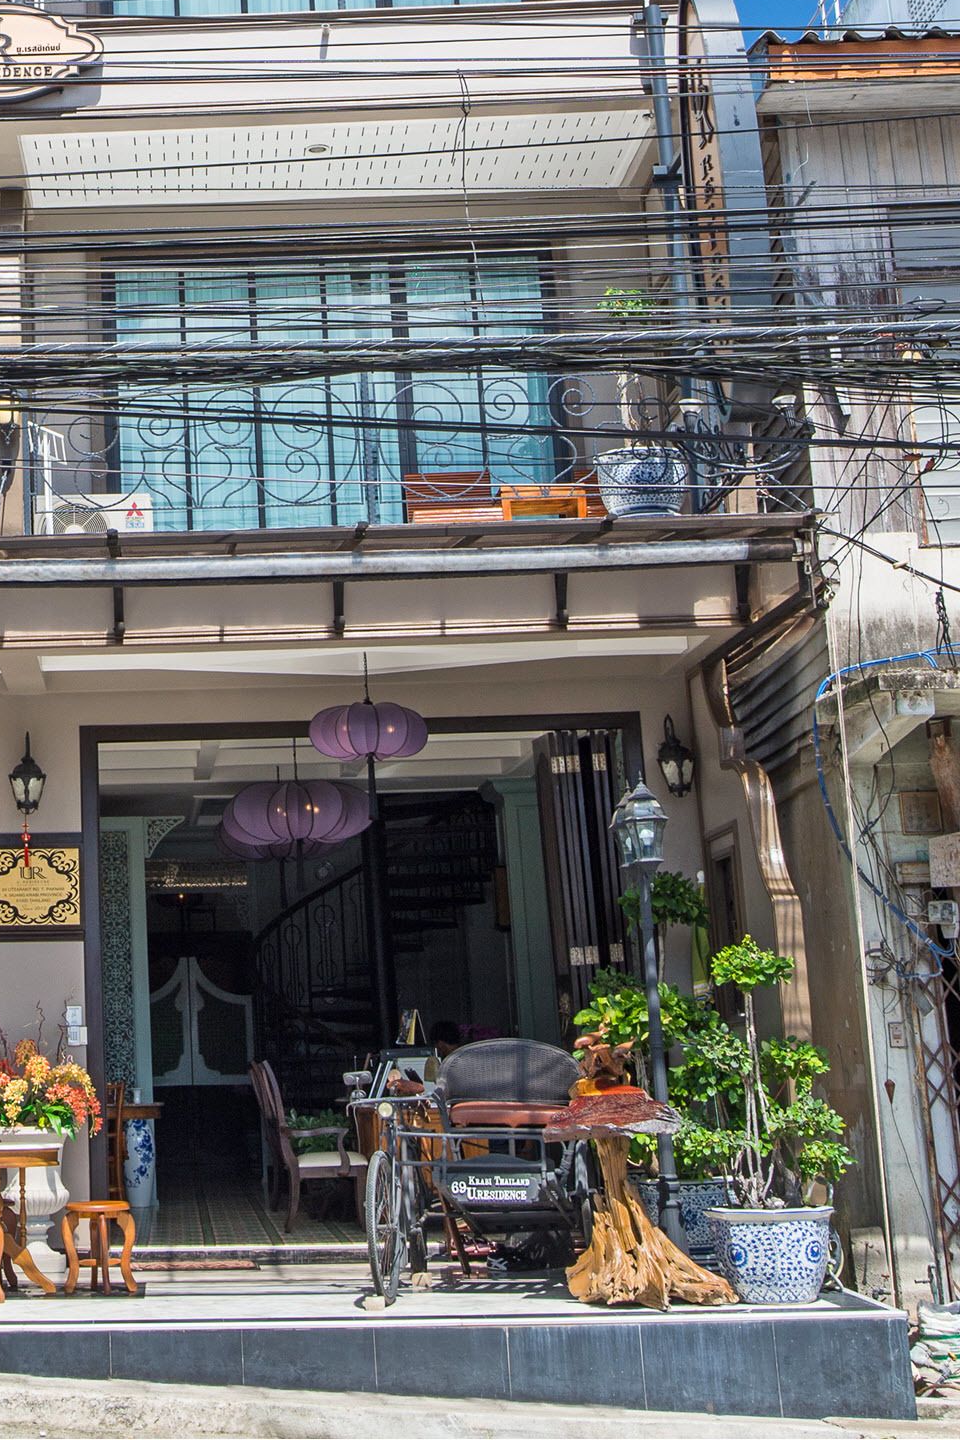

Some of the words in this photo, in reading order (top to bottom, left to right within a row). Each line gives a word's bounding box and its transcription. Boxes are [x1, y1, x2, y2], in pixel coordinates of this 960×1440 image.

[468, 1176, 492, 1186] KRABI
[494, 1175, 530, 1186] THAILAND
[451, 1181, 467, 1194] 69
